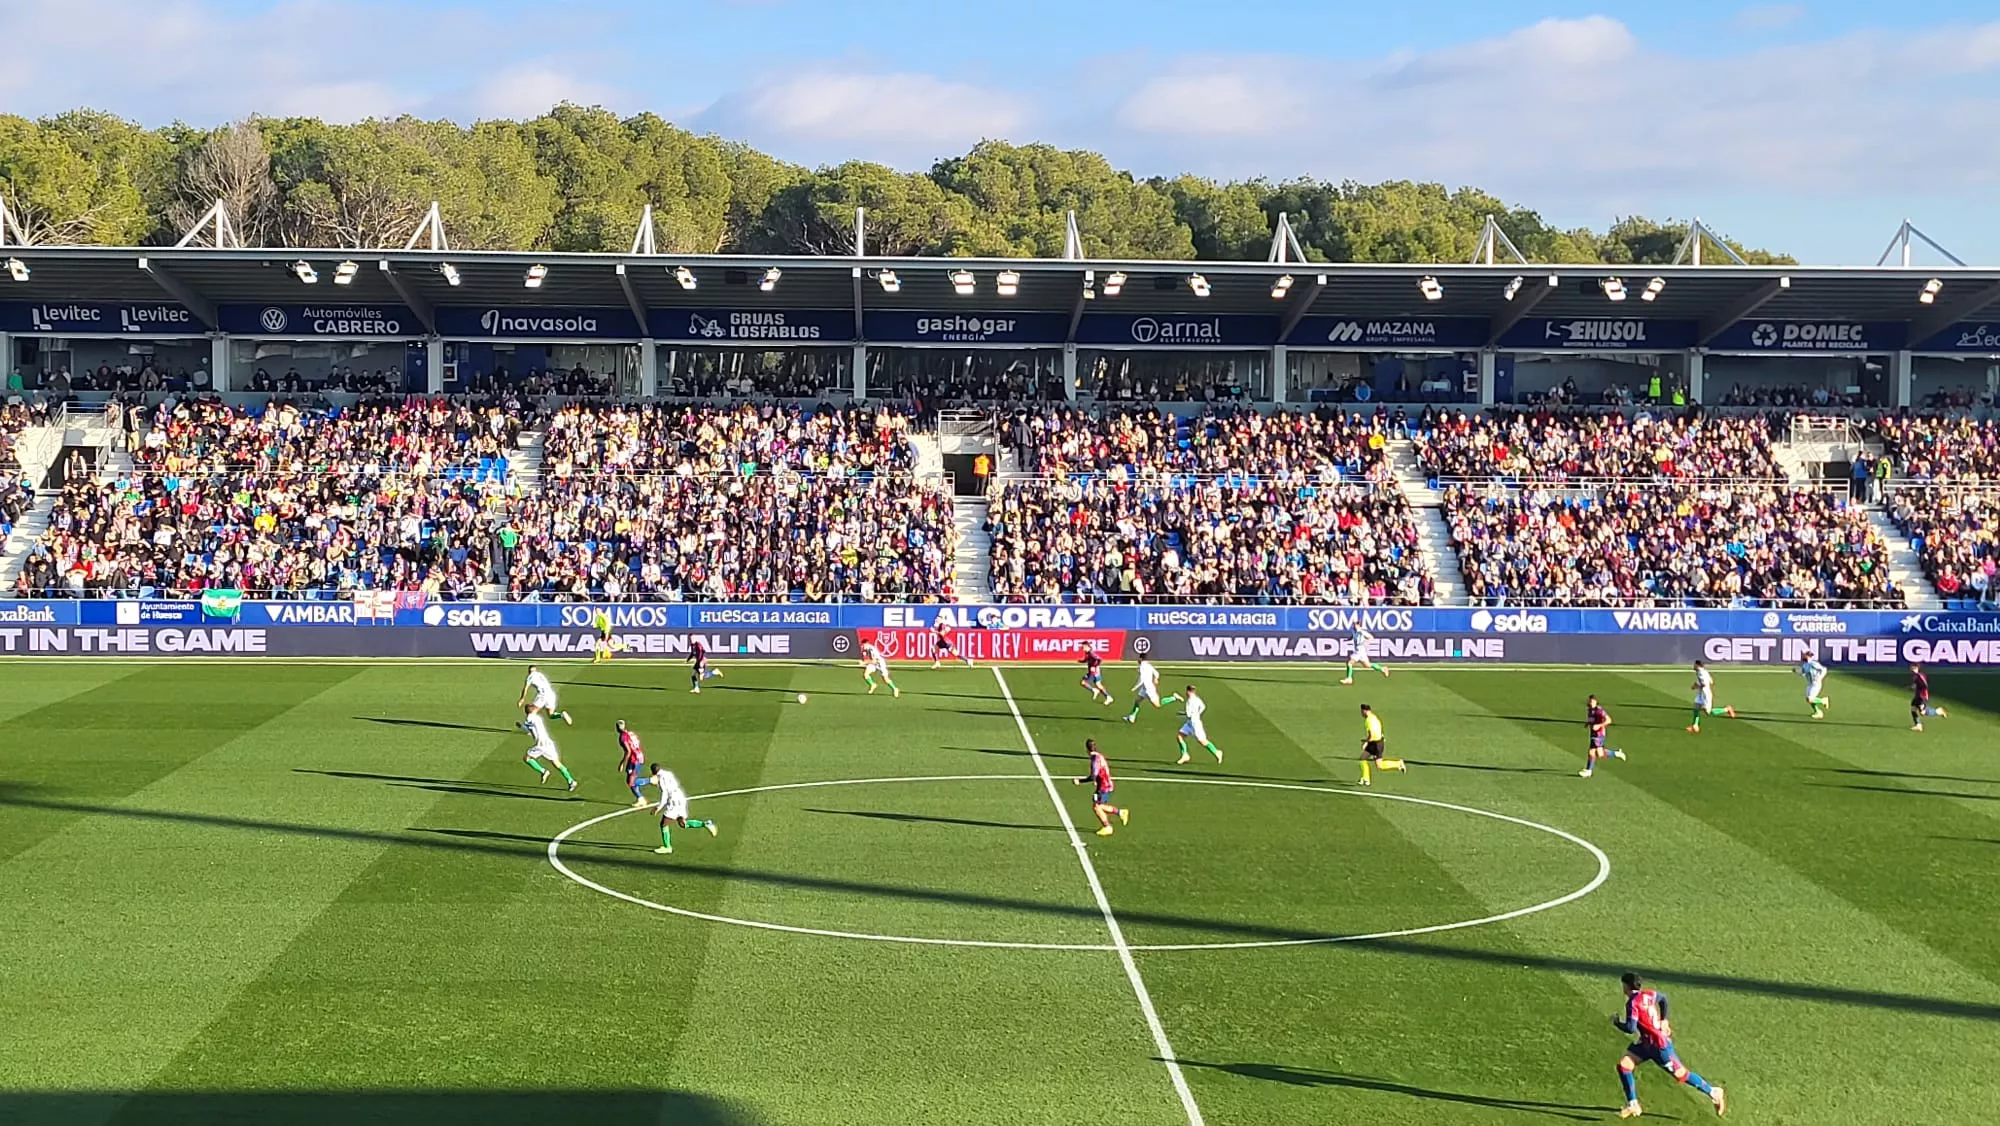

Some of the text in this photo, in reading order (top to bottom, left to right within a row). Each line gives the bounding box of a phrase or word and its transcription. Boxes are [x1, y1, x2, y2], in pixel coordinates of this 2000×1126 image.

[303, 307, 382, 319] Automóviles
[730, 313, 785, 325] GRUAS
[313, 320, 400, 334] CABRERO
[501, 316, 597, 331] navasola
[730, 326, 820, 338] LOSFABLOS
[1160, 317, 1221, 338] arnal
[1366, 322, 1436, 335] MAZANA
[1783, 324, 1863, 340] DOMEC
[141, 602, 195, 611] Ayuntamiento
[281, 605, 354, 623] AMBAR
[447, 605, 501, 626] soka
[883, 607, 925, 627] EL
[1307, 609, 1413, 631] SOMMOS
[1494, 609, 1548, 632] soka
[1628, 611, 1699, 630] AMBAR
[1924, 615, 2000, 633] CaixaBank
[1793, 622, 1847, 633] CABRERO
[29, 628, 67, 651] IN
[73, 628, 149, 651] THE
[155, 629, 267, 652] GAME
[957, 632, 985, 658] DEL
[991, 632, 1022, 659] REY
[1703, 637, 2000, 663] GET IN THE GAME
